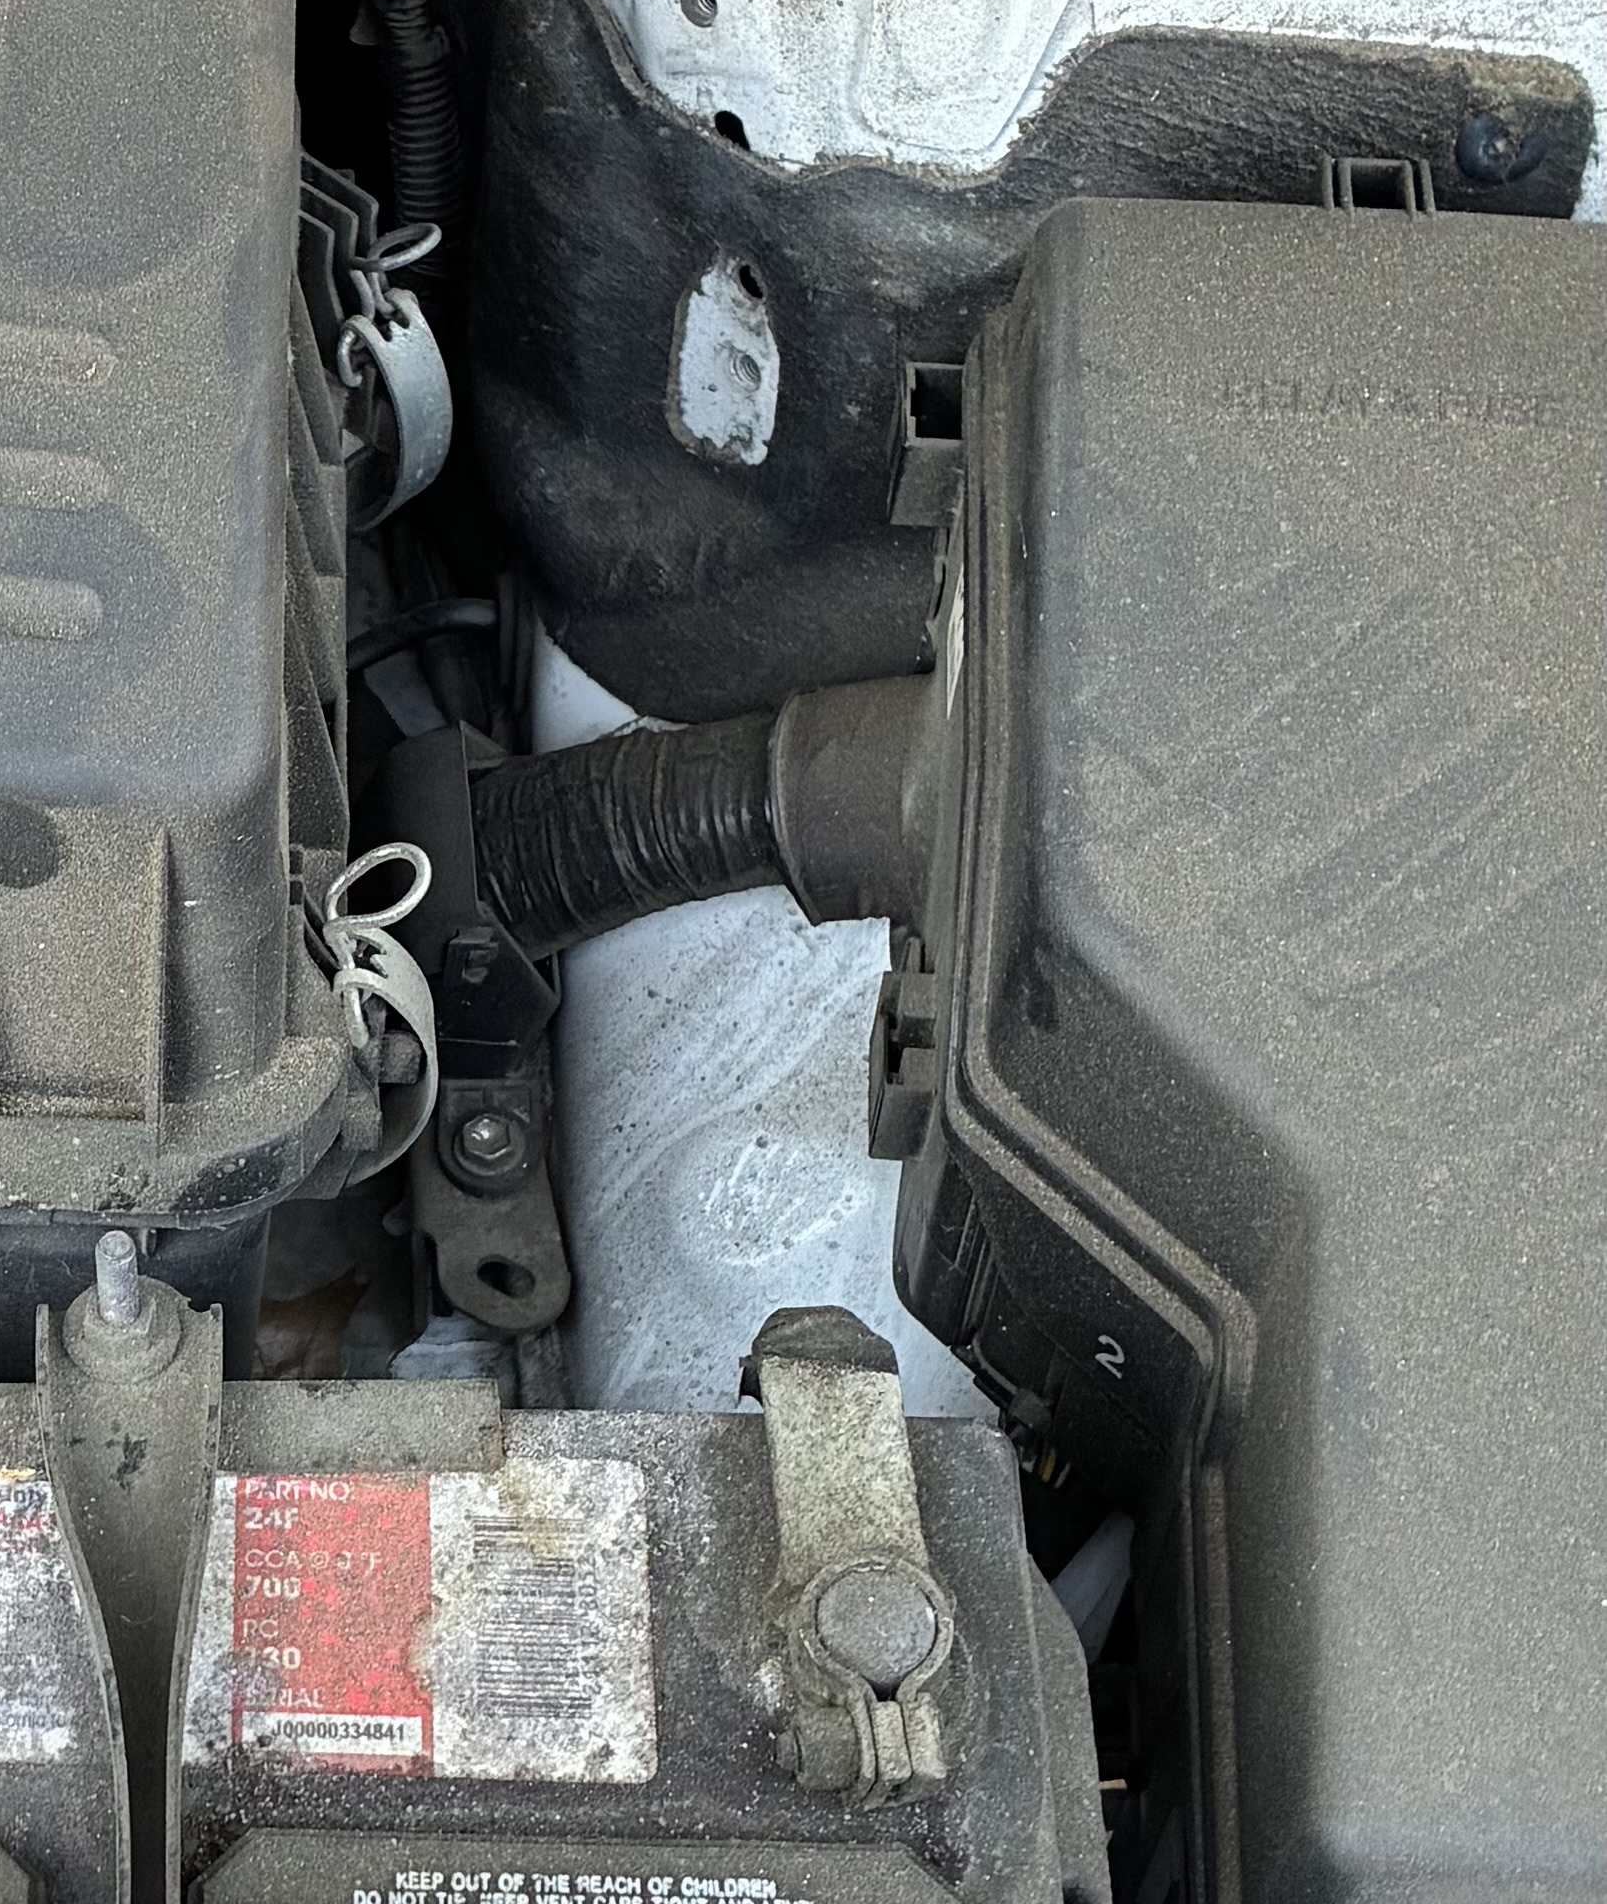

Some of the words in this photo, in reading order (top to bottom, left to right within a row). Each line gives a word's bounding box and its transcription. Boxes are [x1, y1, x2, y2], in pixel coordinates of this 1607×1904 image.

[244, 1480, 301, 1500] PART
[244, 1507, 299, 1529] 24F
[244, 1548, 302, 1570] CCA
[244, 1574, 301, 1598] 700
[242, 1617, 280, 1637] RC
[395, 1870, 444, 1892] KEEP
[450, 1872, 492, 1893] OUT
[498, 1873, 526, 1893] OF
[531, 1873, 571, 1895] THE
[575, 1874, 642, 1895] REACH
[647, 1875, 675, 1896] OF
[680, 1876, 777, 1899] CHILDREN
